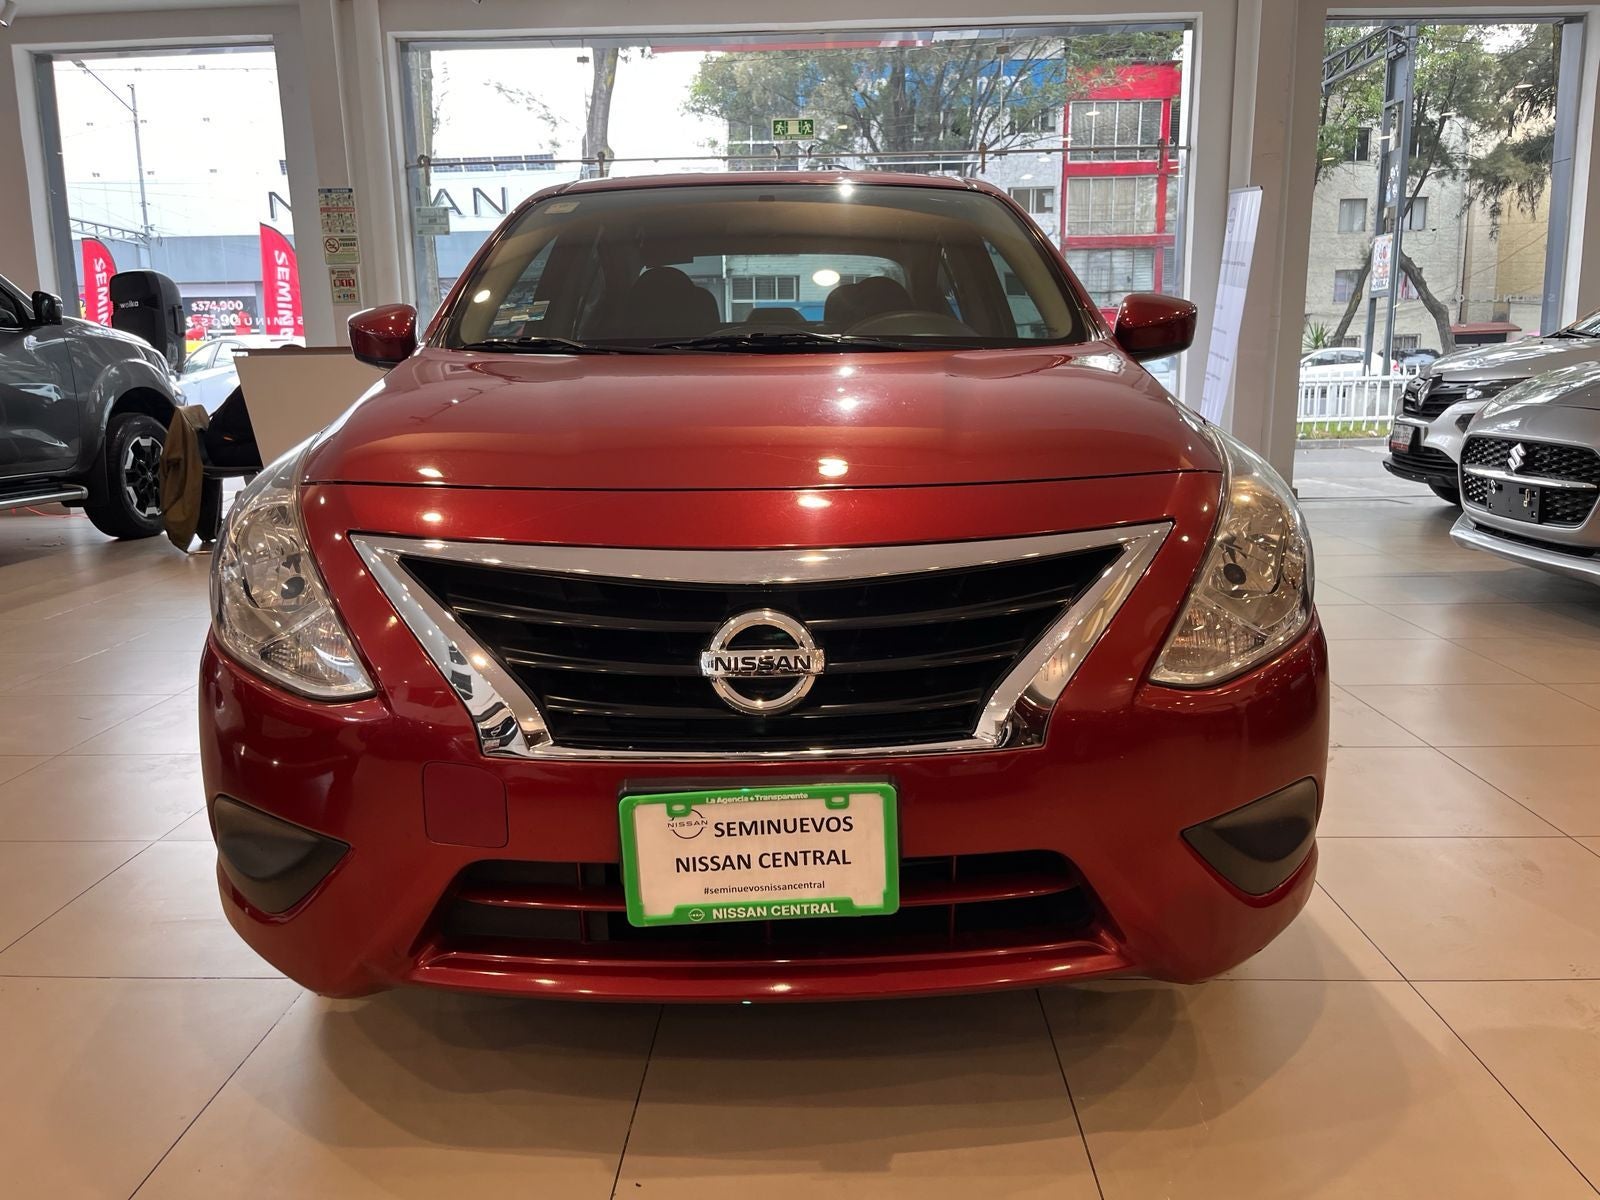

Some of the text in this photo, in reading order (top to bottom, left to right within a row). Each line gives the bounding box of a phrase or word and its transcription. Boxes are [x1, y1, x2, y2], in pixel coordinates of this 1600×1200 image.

[191, 300, 243, 312] $374,900
[714, 655, 811, 671] NISSAN
[717, 796, 749, 804] Agencia
[667, 816, 853, 837] NISSAN SEMINUEVOS
[675, 849, 851, 873] NISSAN CENTRAL
[703, 880, 825, 895] #seminuevosnissancentral
[712, 906, 767, 919] NISSAN
[771, 902, 838, 917] CENTRAL
